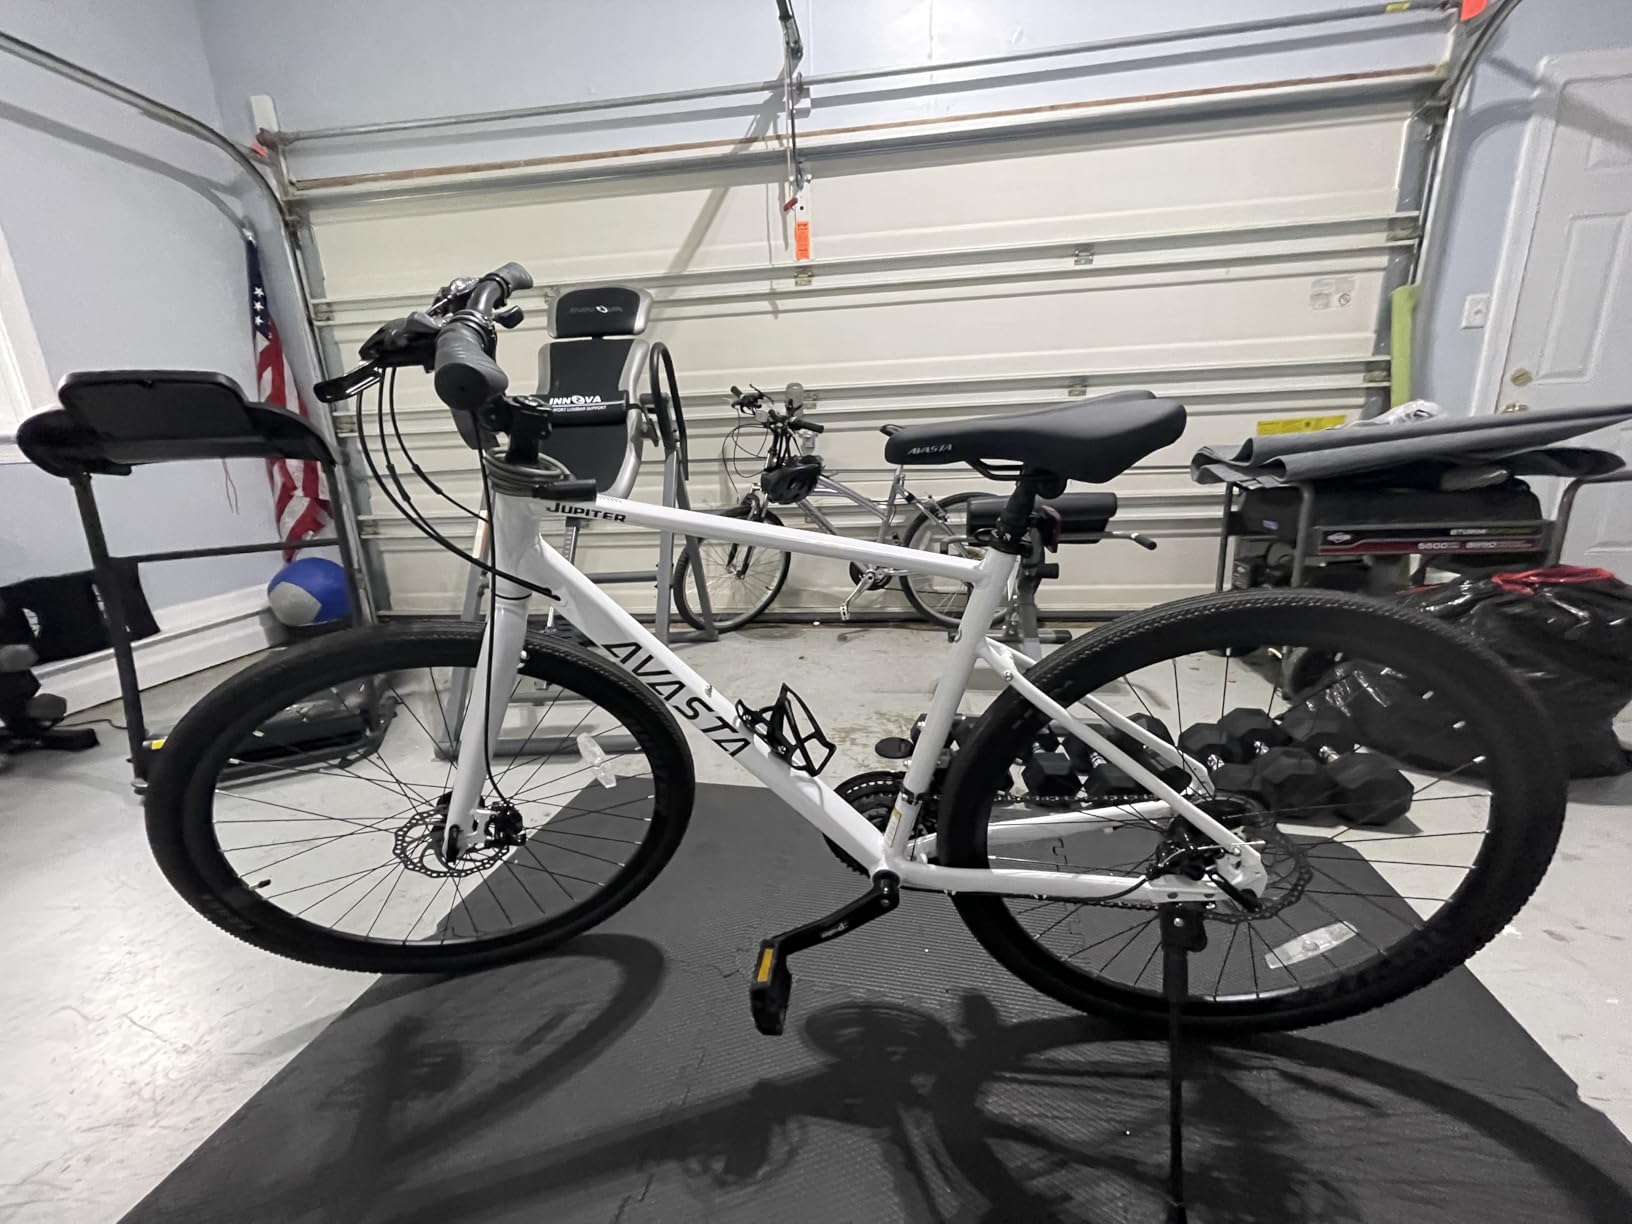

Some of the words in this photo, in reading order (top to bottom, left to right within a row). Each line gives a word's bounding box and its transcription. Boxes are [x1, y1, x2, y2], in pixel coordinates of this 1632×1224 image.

[549, 395, 602, 405] INNOVA
[907, 443, 953, 455] AVASTA
[546, 502, 627, 523] JUPITER
[601, 641, 752, 757] AVASTA
